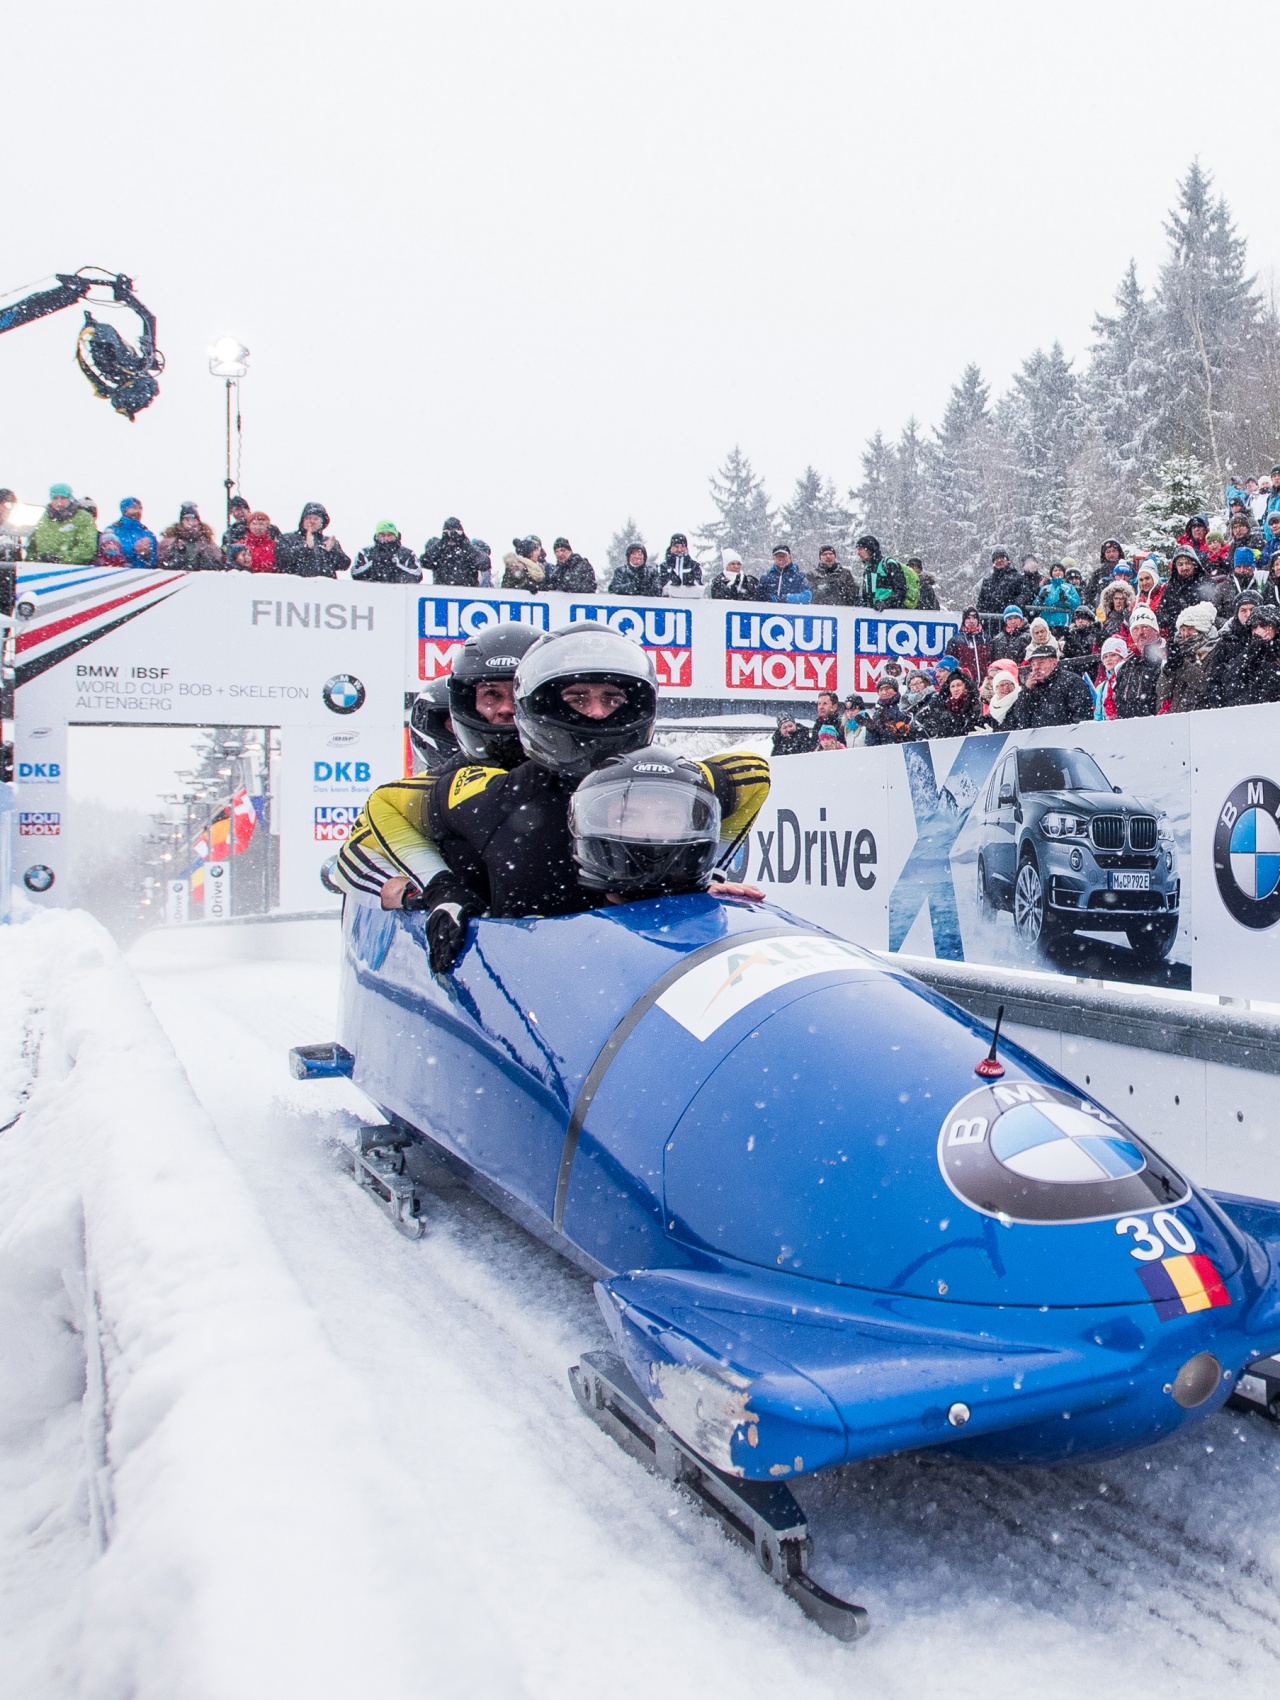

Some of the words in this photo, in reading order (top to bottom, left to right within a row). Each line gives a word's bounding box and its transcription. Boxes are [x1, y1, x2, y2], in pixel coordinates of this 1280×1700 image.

[252, 600, 374, 631] FINISH
[731, 614, 832, 651] LIQUI
[76, 665, 119, 678] BMW
[131, 666, 170, 679] IBSF
[731, 653, 836, 688] MOLY
[76, 680, 136, 694] WORLD
[140, 682, 173, 695] CUP
[179, 683, 212, 696] BOB
[229, 684, 309, 699] SKELETON
[76, 696, 172, 711] ALTENBERG
[18, 763, 61, 777] DKB
[314, 761, 371, 782] DKB
[21, 814, 60, 824] LIQUI
[316, 807, 362, 823] LIQU
[21, 825, 60, 835] MOLY
[756, 807, 878, 891] xDrive
[1115, 1212, 1196, 1261] 30
